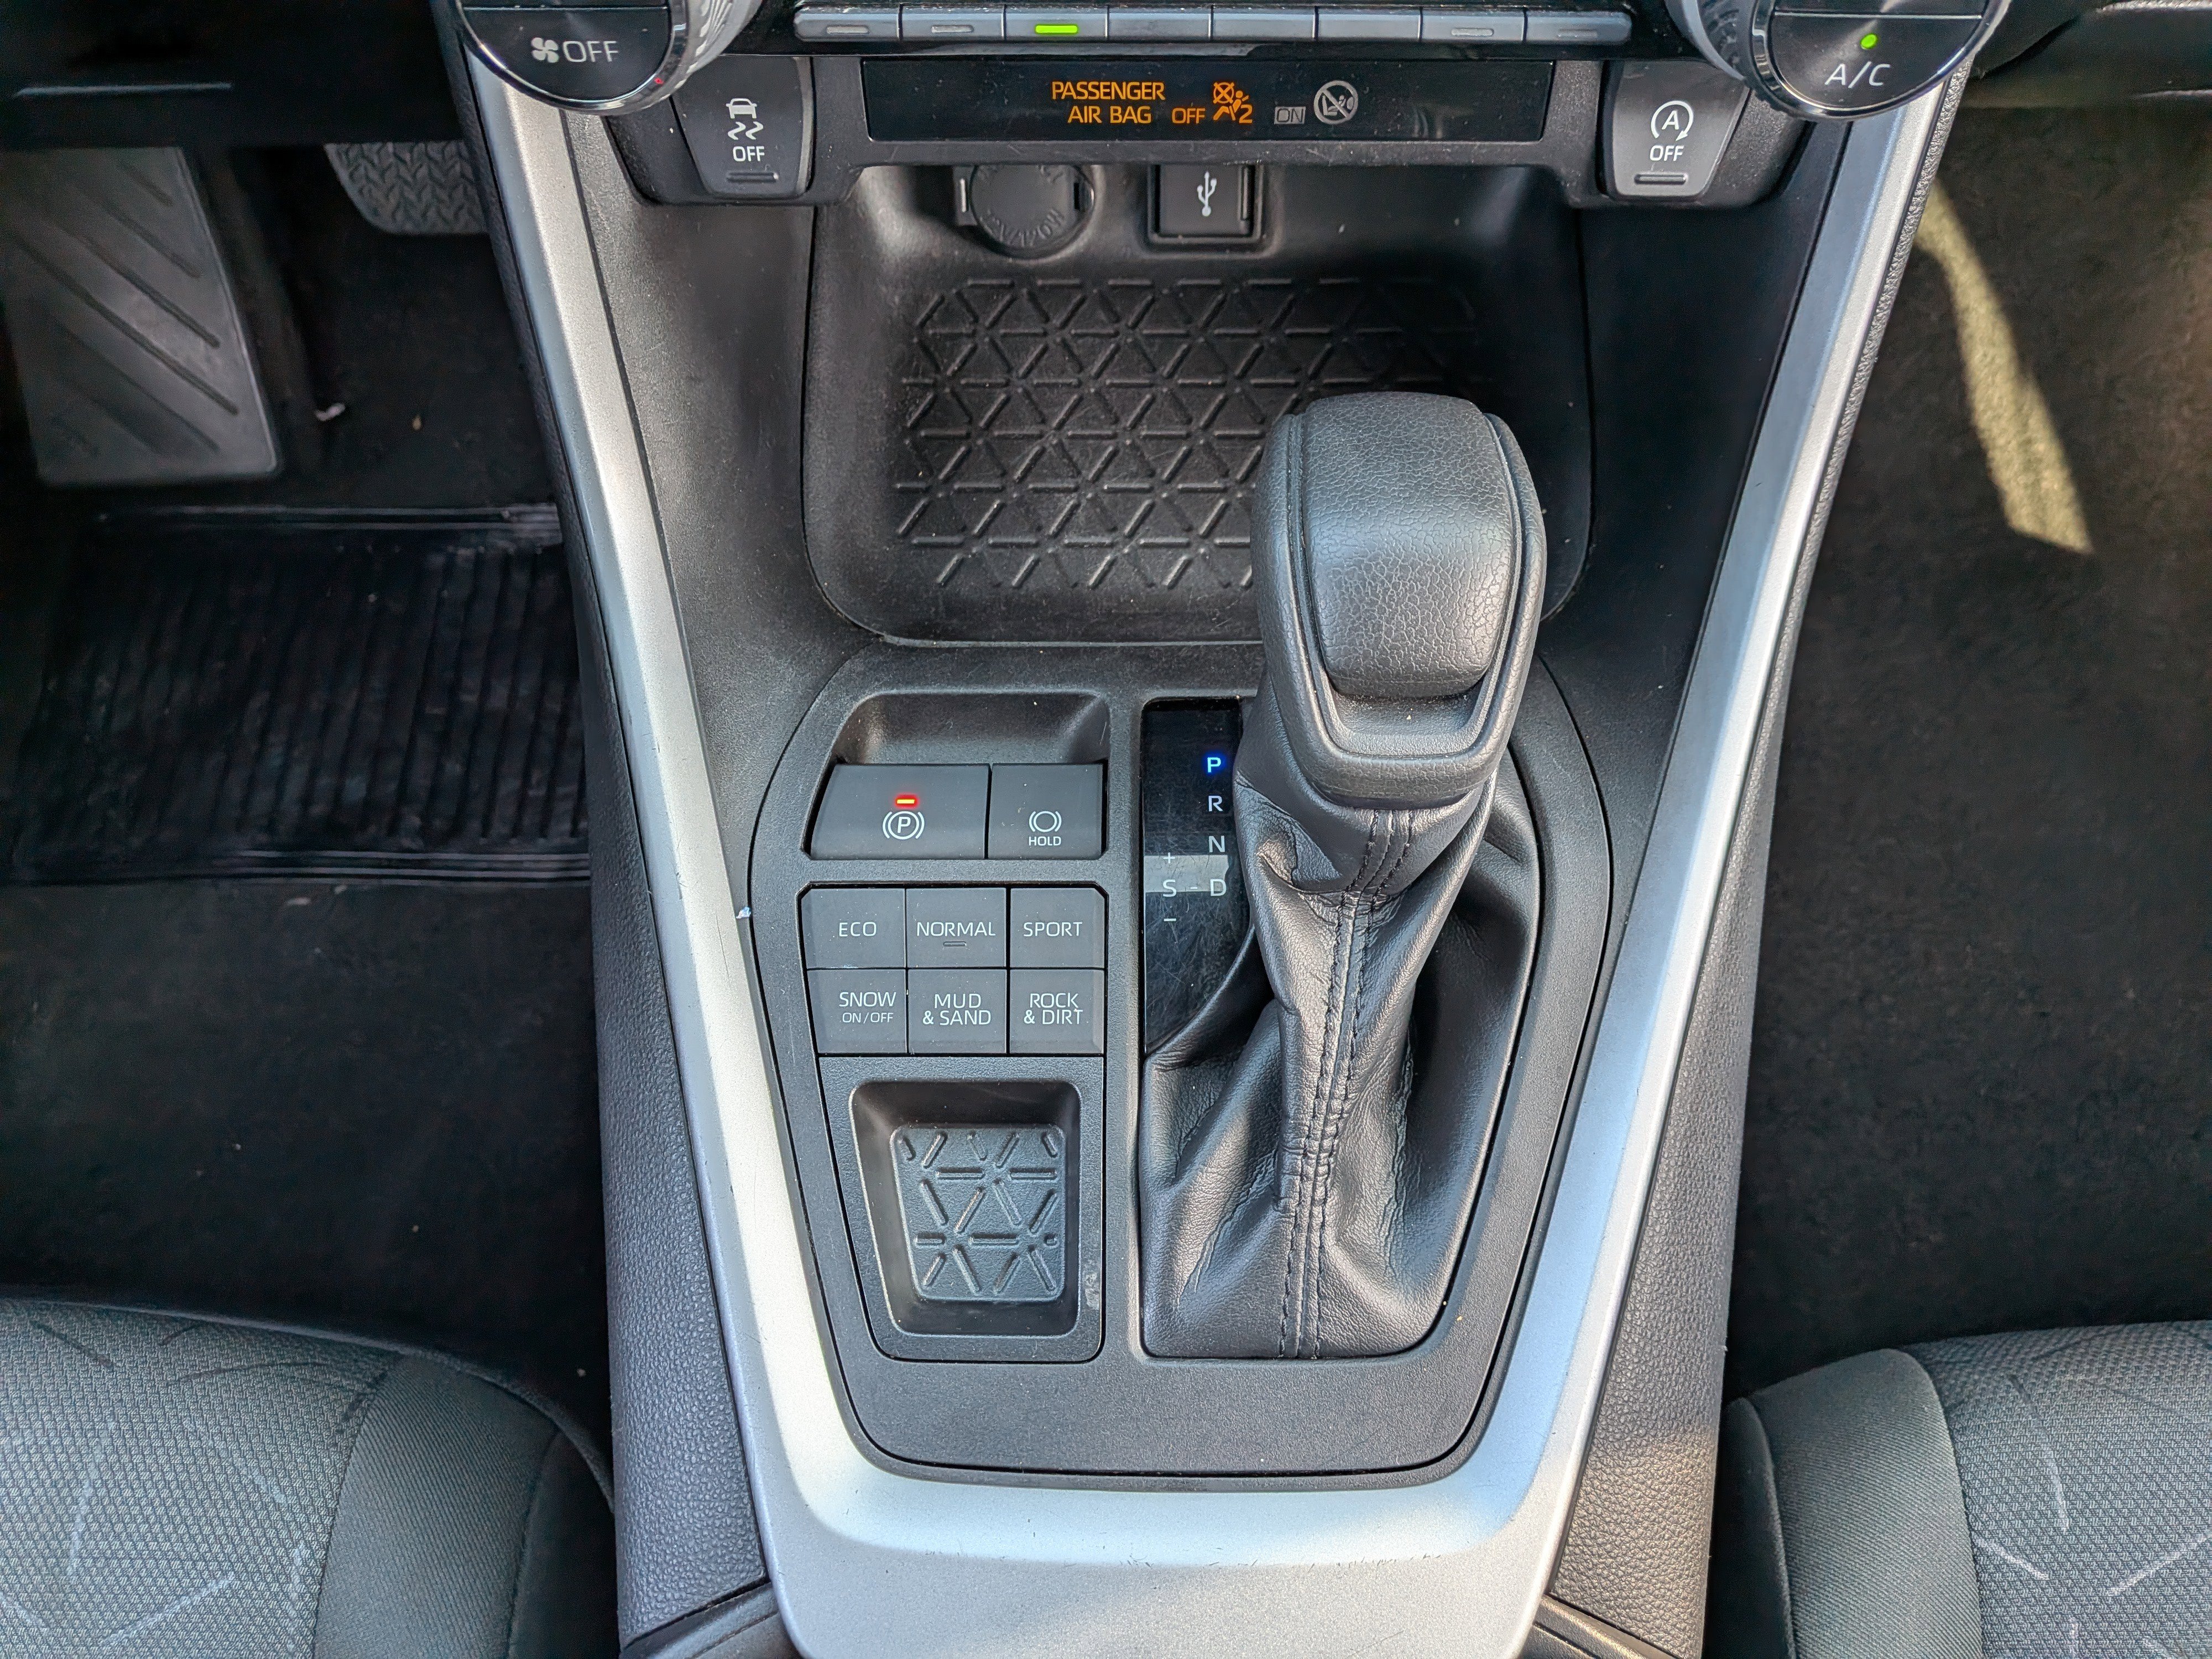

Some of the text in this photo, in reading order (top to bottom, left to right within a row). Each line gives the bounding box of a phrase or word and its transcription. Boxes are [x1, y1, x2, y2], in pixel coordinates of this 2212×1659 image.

[563, 40, 619, 62] OFF
[1824, 61, 1890, 88] A/C
[1052, 81, 1166, 100] PASSENGER
[1067, 105, 1206, 124] AIR BAG OFF
[1277, 108, 1303, 123] ON
[1662, 110, 1679, 130] A
[733, 145, 765, 162] OFF
[1650, 144, 1684, 161] OFF
[1207, 757, 1222, 773] P
[1208, 795, 1223, 812] R
[897, 816, 911, 833] P
[1029, 836, 1062, 846] HOLD
[1208, 835, 1225, 853] N
[1162, 878, 1177, 897] S
[1209, 878, 1227, 896] D
[839, 921, 877, 937] ECO
[917, 921, 996, 937] NORMAL
[1023, 921, 1083, 937] SPORT
[839, 992, 896, 1007] SNOW
[934, 993, 981, 1009] MUD
[1030, 992, 1079, 1008] ROCK
[842, 1012, 894, 1024] ON/OFF
[922, 1010, 991, 1026] & SAND
[1024, 1008, 1083, 1025] & DIRT
